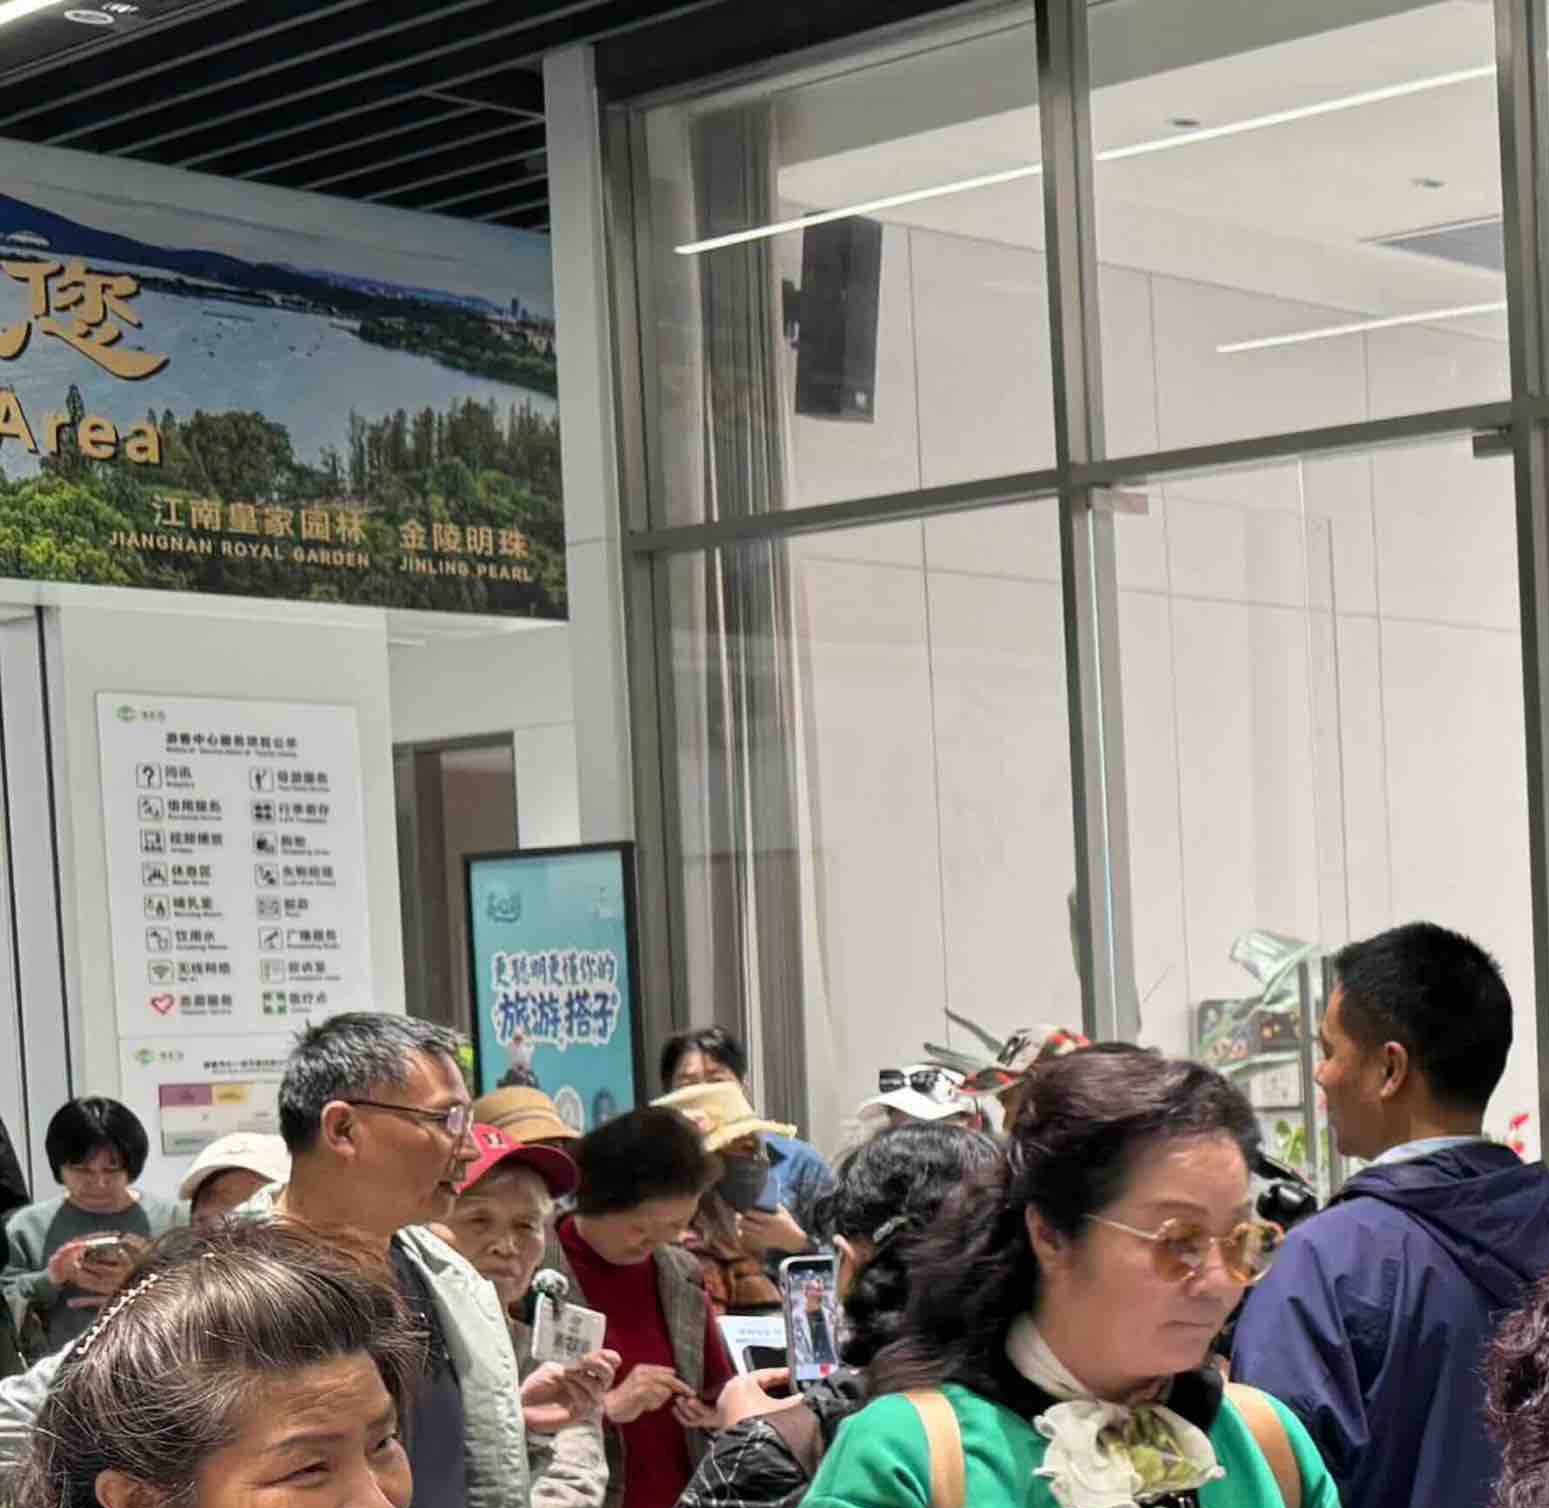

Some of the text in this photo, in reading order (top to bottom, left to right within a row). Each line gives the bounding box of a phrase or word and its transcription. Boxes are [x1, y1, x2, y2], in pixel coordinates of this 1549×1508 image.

[0, 384, 163, 466] Area
[110, 531, 532, 583] JIANGNAN ROYAL GARDEN JINLING PEARL
[399, 518, 528, 559] 金陵明珠
[498, 990, 616, 1042] 旅游搭子
